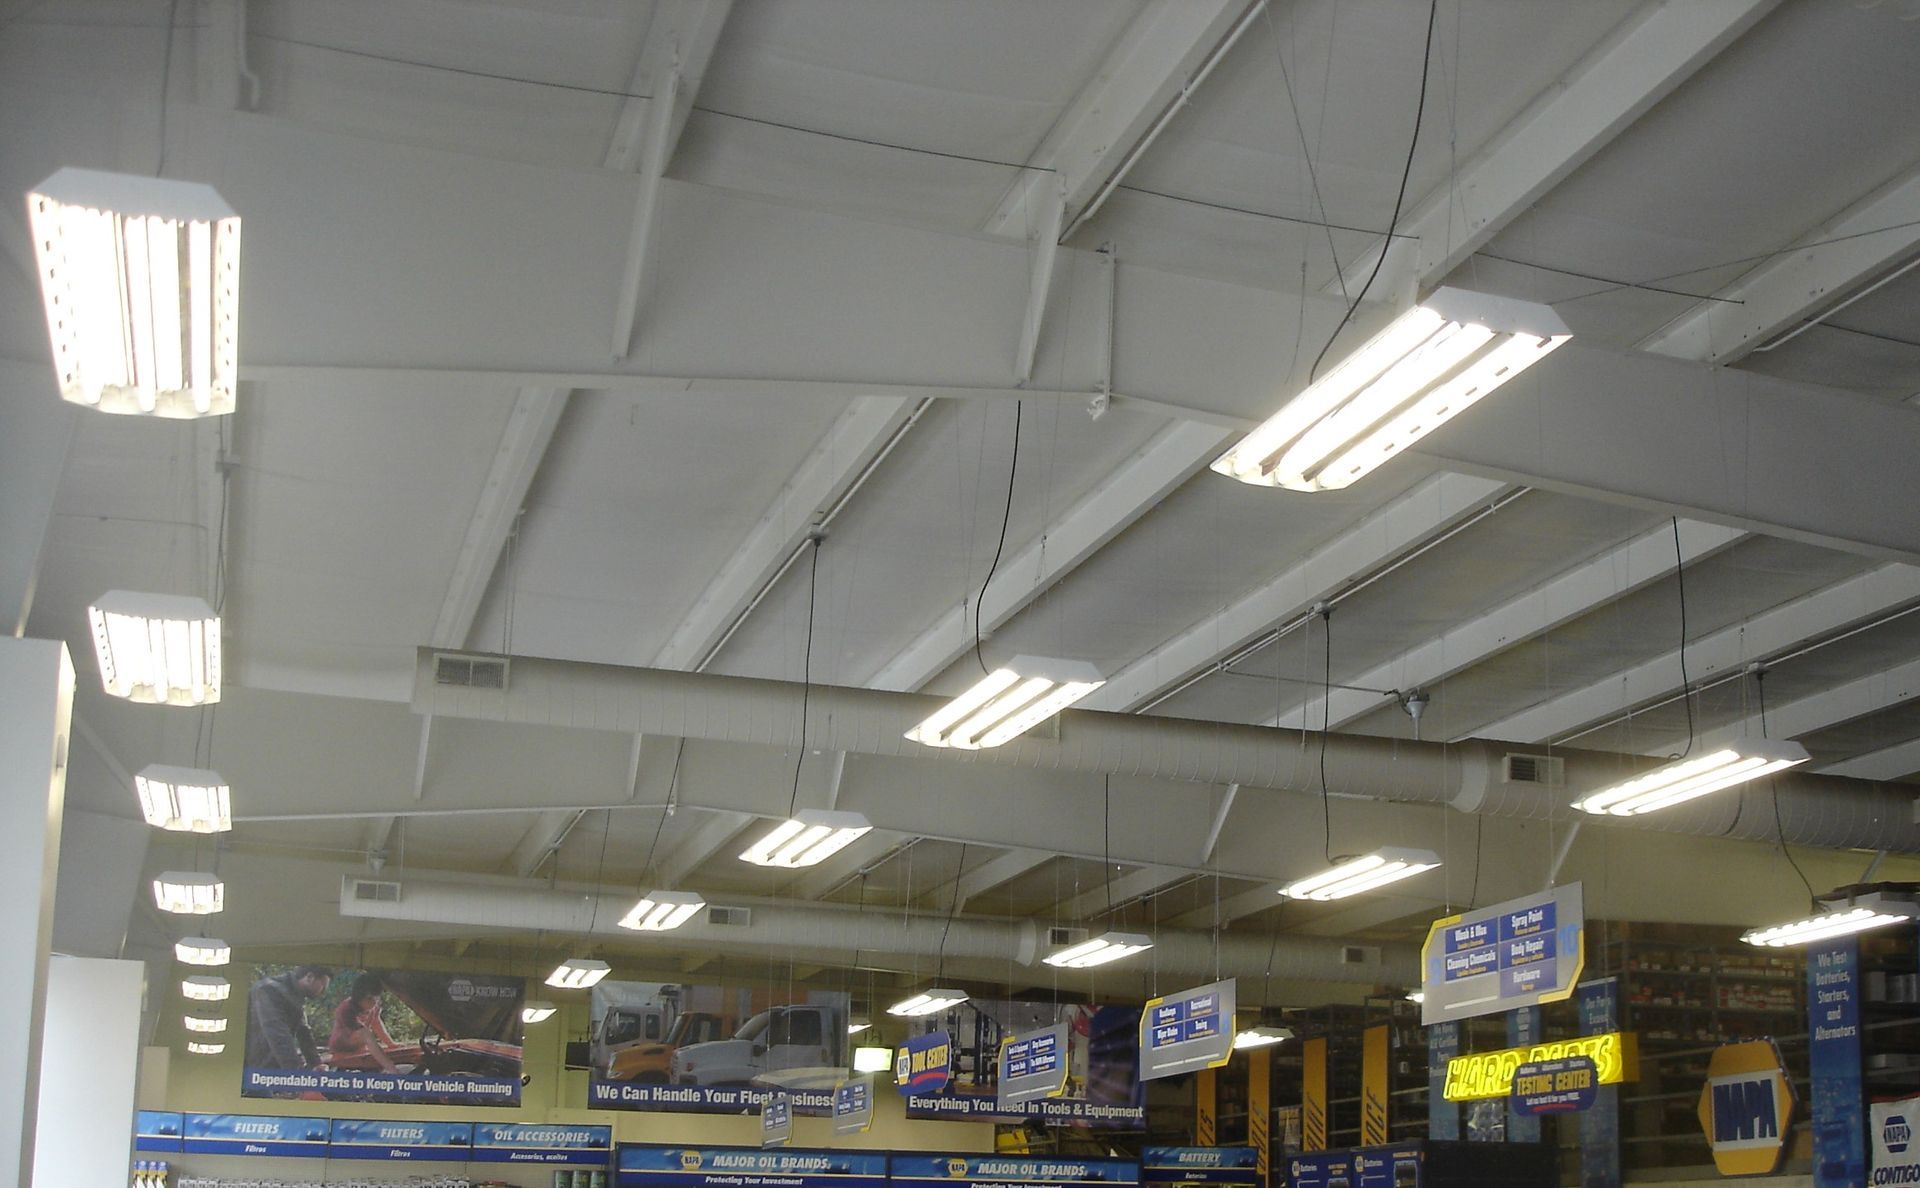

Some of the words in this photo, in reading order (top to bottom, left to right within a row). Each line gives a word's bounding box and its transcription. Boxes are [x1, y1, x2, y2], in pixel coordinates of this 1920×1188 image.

[1818, 953, 1831, 967] We
[1832, 951, 1847, 964] Test
[1816, 970, 1851, 986] Batteries,
[1818, 990, 1850, 1004] Starters,
[1827, 1005, 1841, 1020] and
[1815, 1025, 1856, 1040] Alternators
[928, 1044, 948, 1069] CENTER
[1443, 1052, 1521, 1099] HARD
[1517, 1074, 1552, 1096] TESTING
[1555, 1069, 1591, 1091] CENTER
[252, 1073, 318, 1088] Dependable
[321, 1076, 349, 1088] Parts
[352, 1077, 363, 1089] to
[367, 1078, 394, 1091] Keep
[397, 1079, 423, 1091] Your
[426, 1080, 464, 1093] Vehicle
[467, 1082, 512, 1096] Running
[597, 1085, 617, 1099] We
[621, 1086, 649, 1100] Can
[652, 1087, 701, 1102] Handle
[705, 1089, 737, 1103] Your
[740, 1091, 773, 1105] Fleet
[909, 1096, 970, 1112] Everything
[972, 1099, 994, 1112] You
[1042, 1102, 1070, 1115] Tools
[1073, 1103, 1083, 1115] &
[1085, 1104, 1143, 1118] Equipment
[1713, 1079, 1778, 1142] NAPA
[234, 1122, 280, 1134] FILTERS
[380, 1128, 424, 1139] FILTERS
[1886, 1126, 1907, 1143] NAPA
[494, 1130, 513, 1141] OIL
[517, 1130, 590, 1143] ACCESSORIES
[713, 1155, 755, 1167] MAJOR
[758, 1156, 777, 1168] OIL
[780, 1157, 828, 1169] BRANDS
[1178, 1152, 1220, 1163] BATTERY
[978, 1163, 1018, 1174] MAJOR
[1020, 1164, 1037, 1175] OIL
[1040, 1164, 1085, 1176] BRANDS
[705, 1176, 743, 1185] Protecting
[744, 1177, 761, 1185] Your
[762, 1177, 803, 1185] Investment
